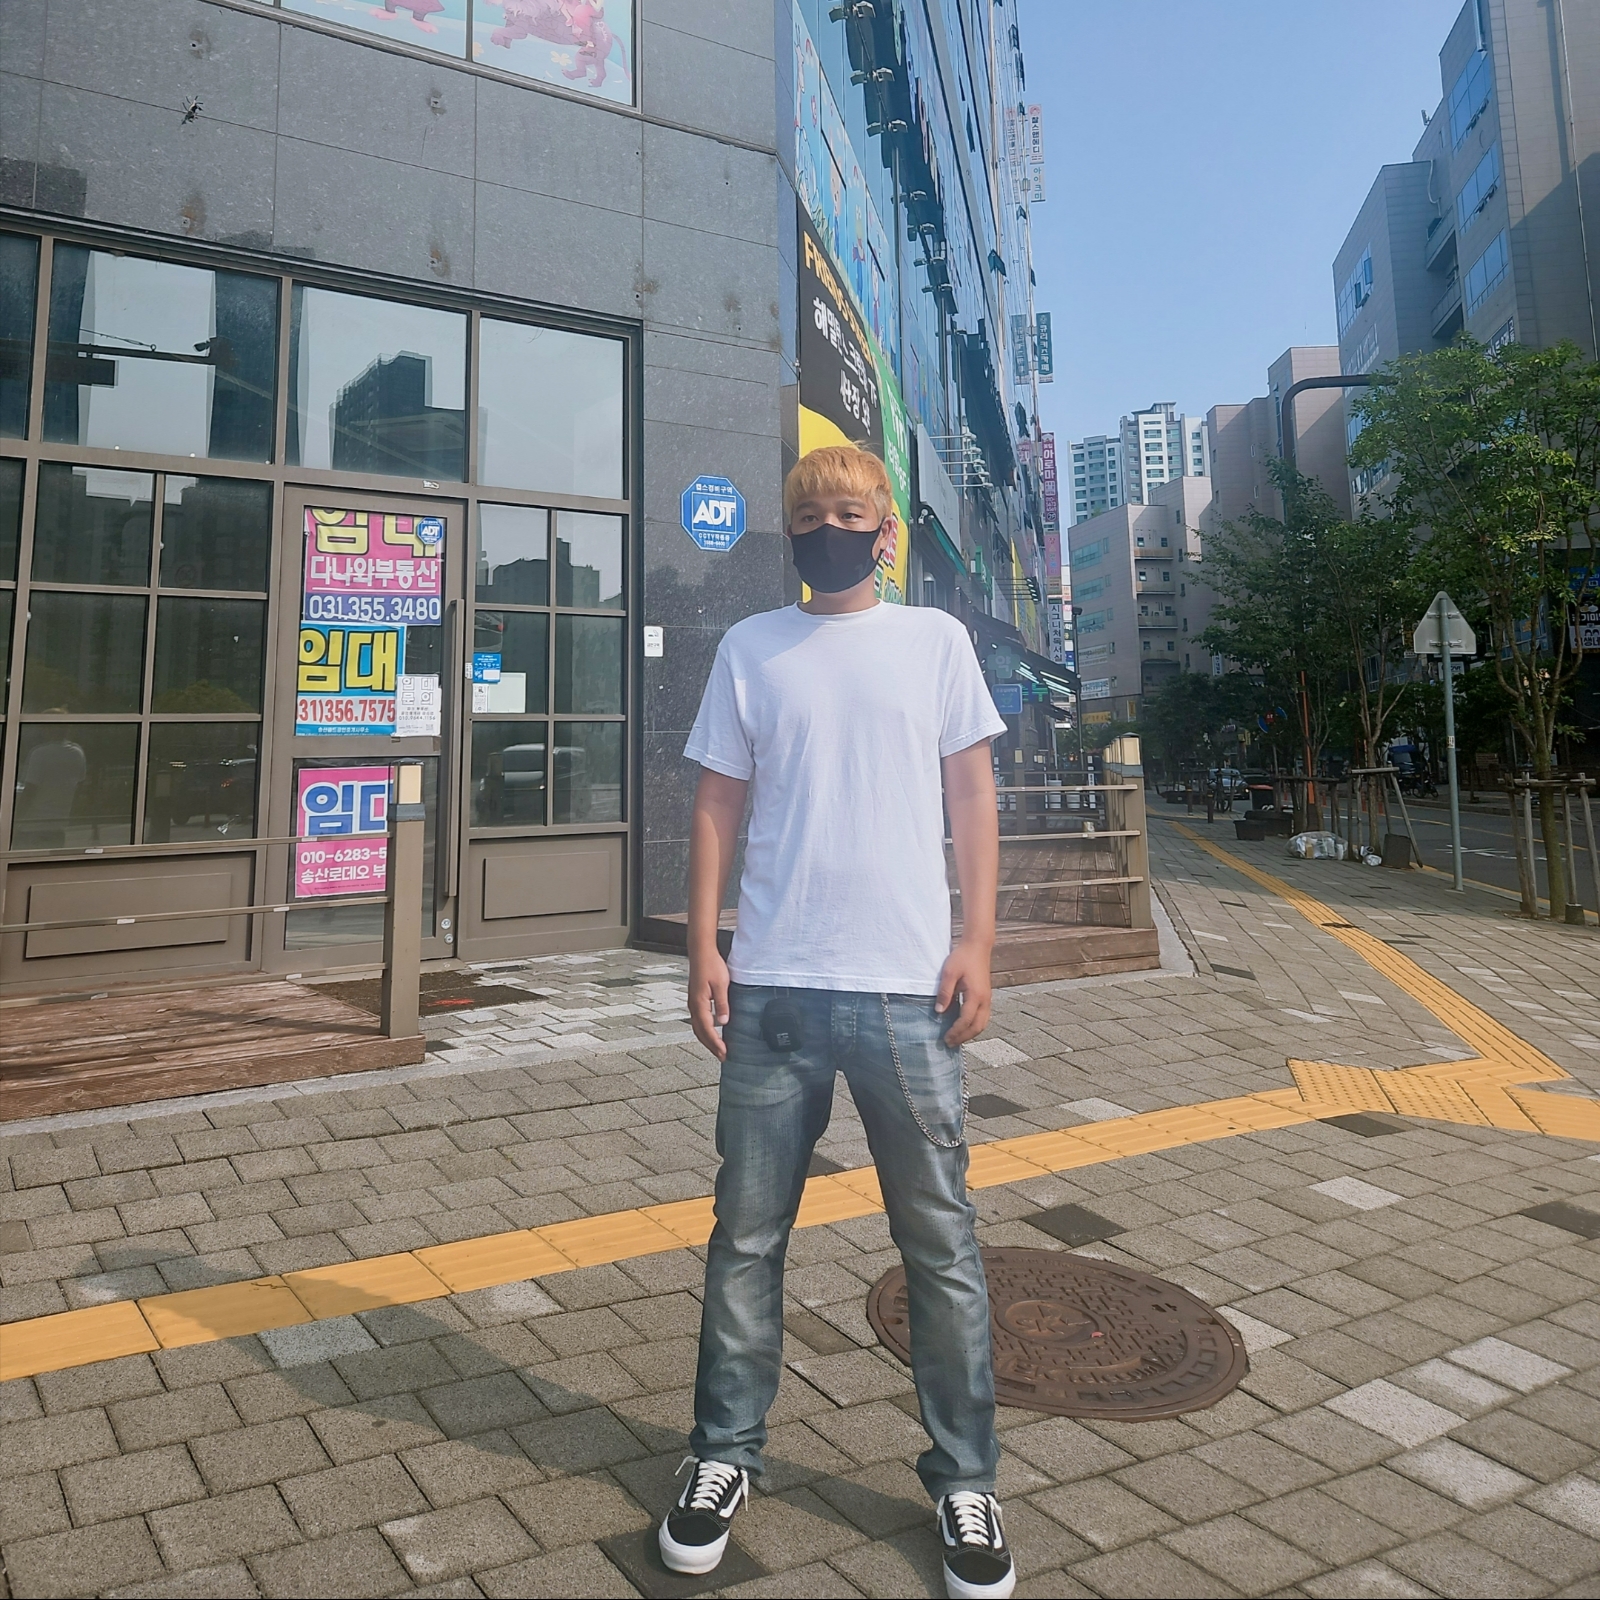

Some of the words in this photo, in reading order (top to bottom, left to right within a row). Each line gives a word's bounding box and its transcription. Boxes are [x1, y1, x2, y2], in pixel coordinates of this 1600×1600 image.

[1043, 449, 1055, 479] 아로마
[692, 499, 736, 527] ADT
[421, 525, 440, 536] ADT
[310, 555, 438, 589] 다나와부동산
[309, 595, 440, 621] 031.355.3480
[1051, 605, 1062, 662] 시그니처독서실
[297, 628, 398, 693] 임대
[296, 699, 396, 723] 31)356.7575
[300, 847, 387, 864] 010-6283-5
[301, 866, 370, 884] 송산로데오
